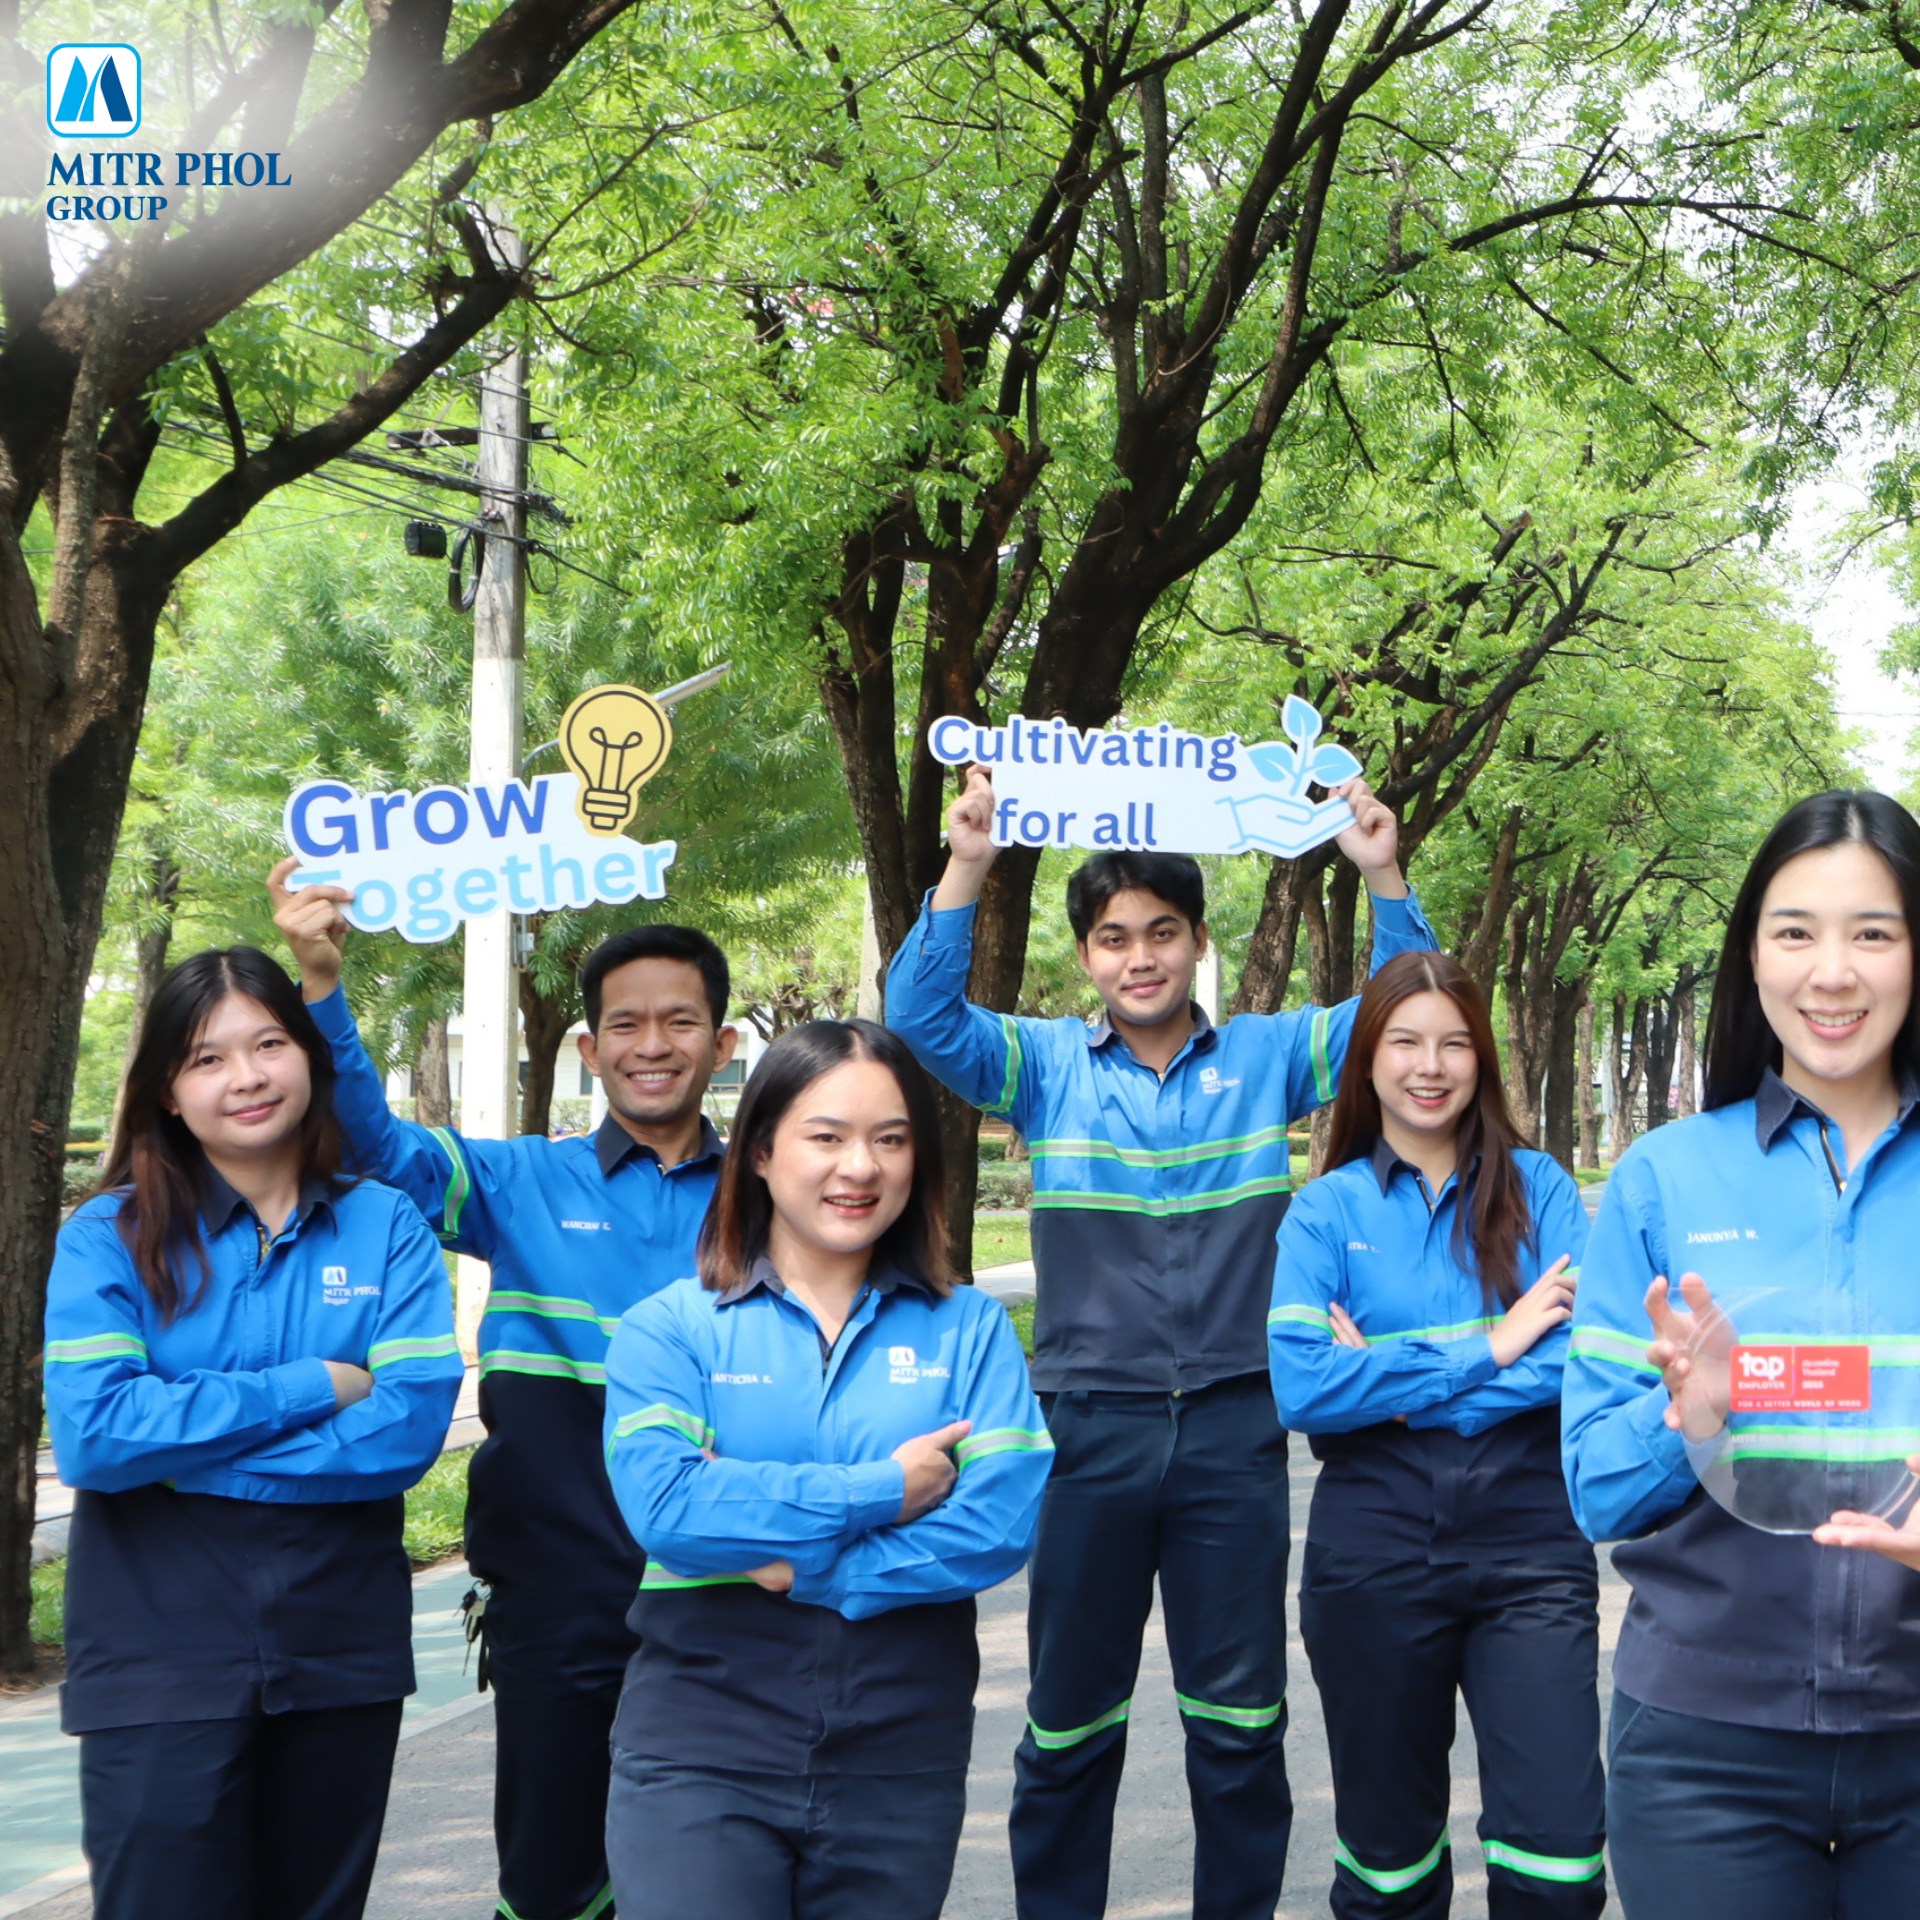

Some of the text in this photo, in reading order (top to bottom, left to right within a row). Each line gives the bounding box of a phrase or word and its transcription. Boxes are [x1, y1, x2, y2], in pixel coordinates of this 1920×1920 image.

[933, 719, 1237, 781] Cultivating
[290, 780, 549, 858] Grow
[995, 797, 1157, 846] for all
[1686, 1228, 1759, 1244] JANUNYA W.
[323, 1287, 352, 1297] MITR
[1738, 1351, 1785, 1381] top
[1738, 1381, 1786, 1390] EMPLOYER
